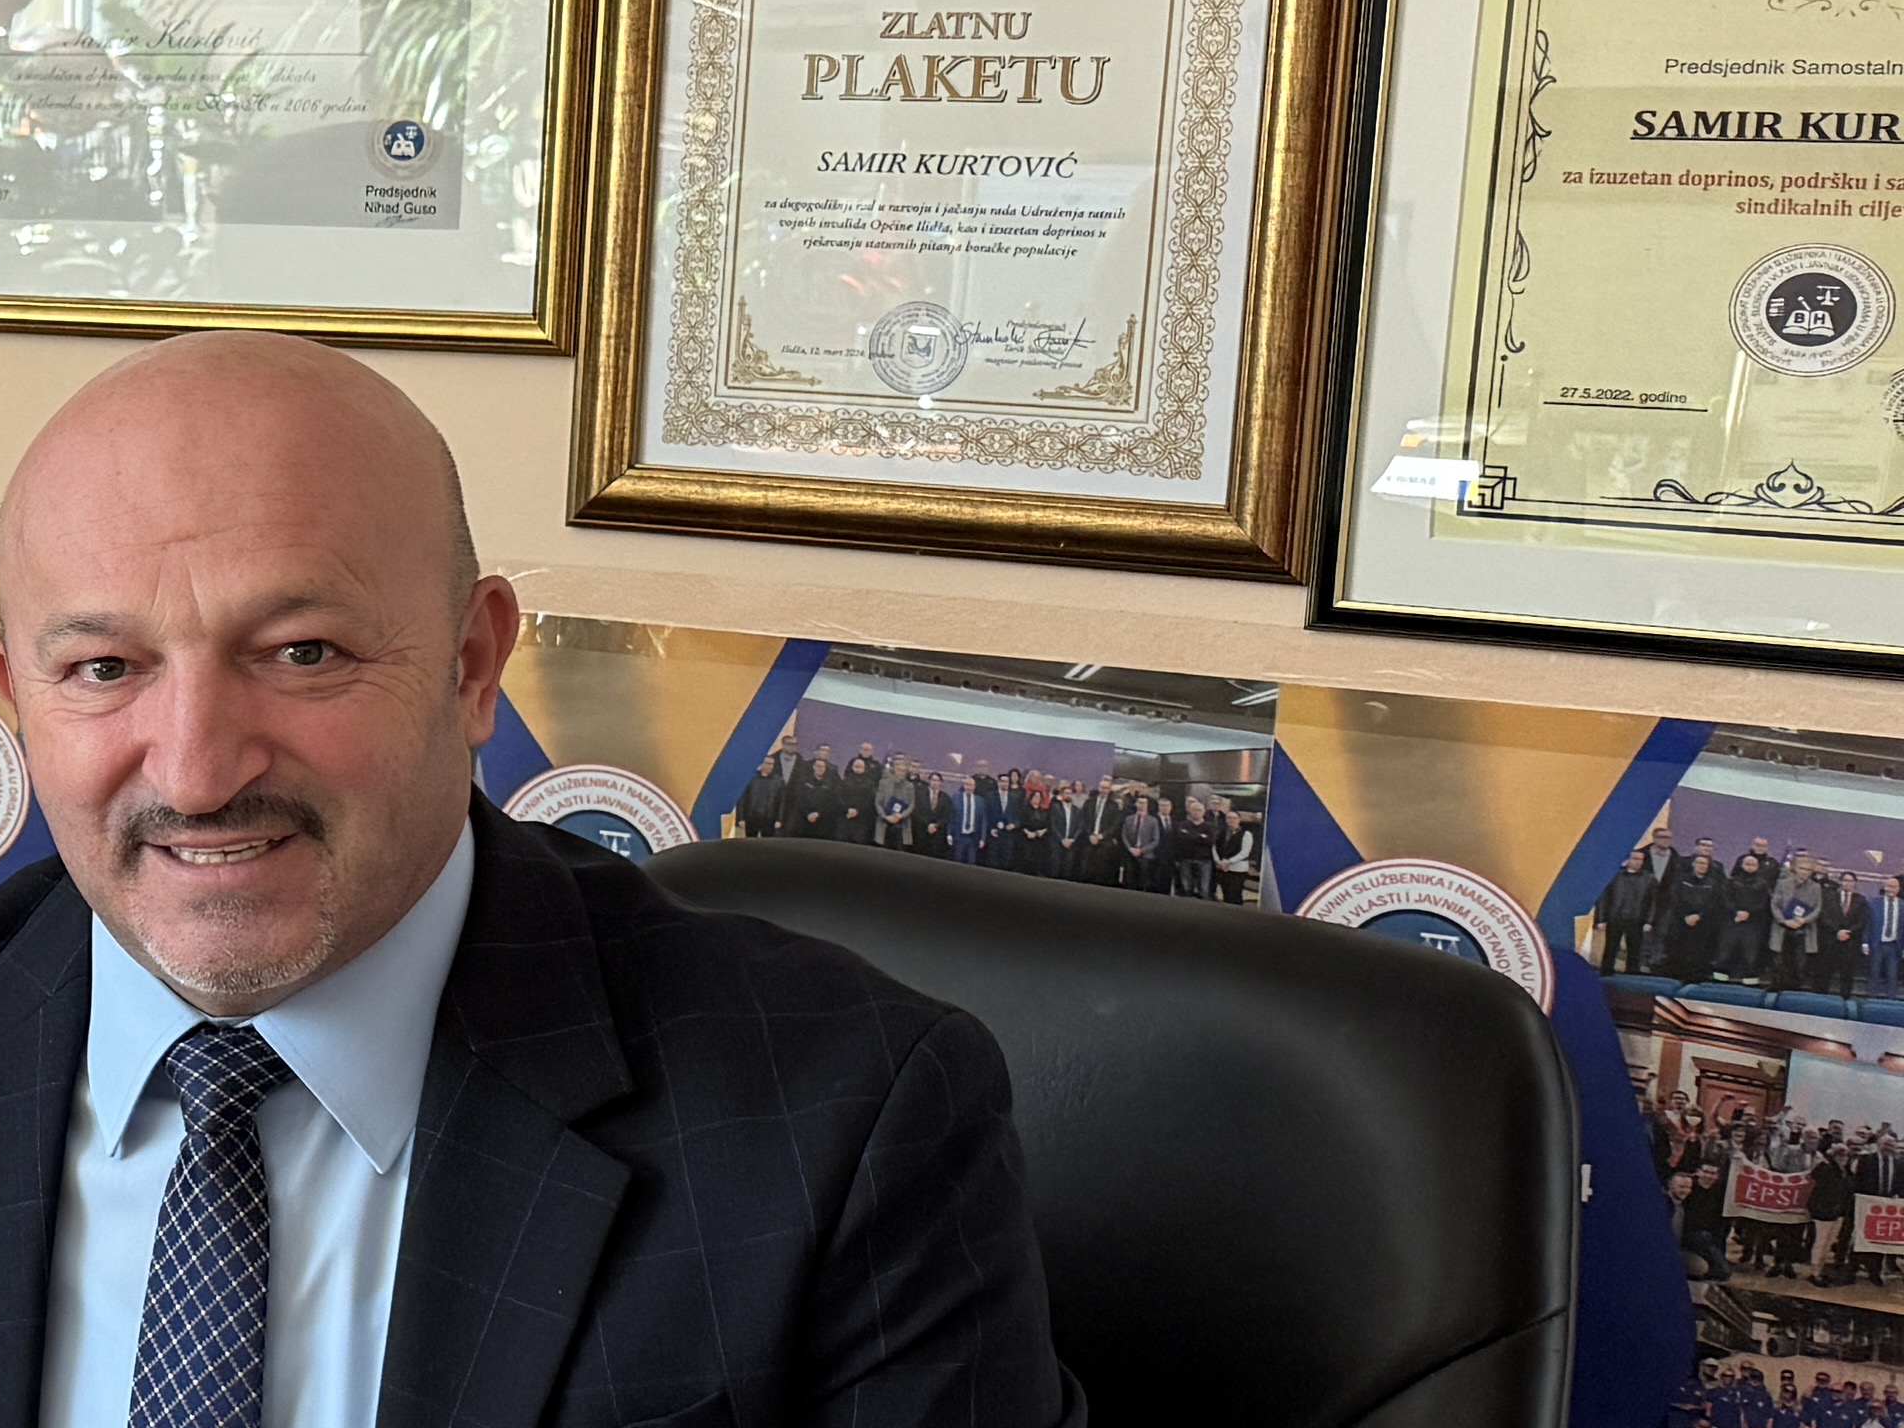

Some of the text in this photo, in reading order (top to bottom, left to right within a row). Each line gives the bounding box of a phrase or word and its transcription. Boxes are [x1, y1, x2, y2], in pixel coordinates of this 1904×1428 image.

[879, 10, 1032, 40] ZLATNU
[1664, 58, 1785, 78] Predsjednik
[800, 53, 1111, 106] PLAKETU
[1632, 110, 1903, 142] SAMIR KUR
[817, 151, 1078, 180] SAMIR KURTOVIĆ
[1589, 168, 1868, 196] izuzetan doprinos, podršku
[364, 184, 438, 201] Predsjednik
[364, 200, 400, 216] Nihad
[1020, 205, 1084, 222] Udruženja
[1734, 197, 1854, 217] sindikalnih
[1042, 223, 1095, 240] doprinos
[1013, 243, 1078, 260] populacije
[1560, 387, 1635, 402] 27.5.2022.
[1351, 892, 1473, 922] VLASTI JAVNIM
[1351, 872, 1534, 971] SLUŽBENIKA NAMJEŠTENIKA
